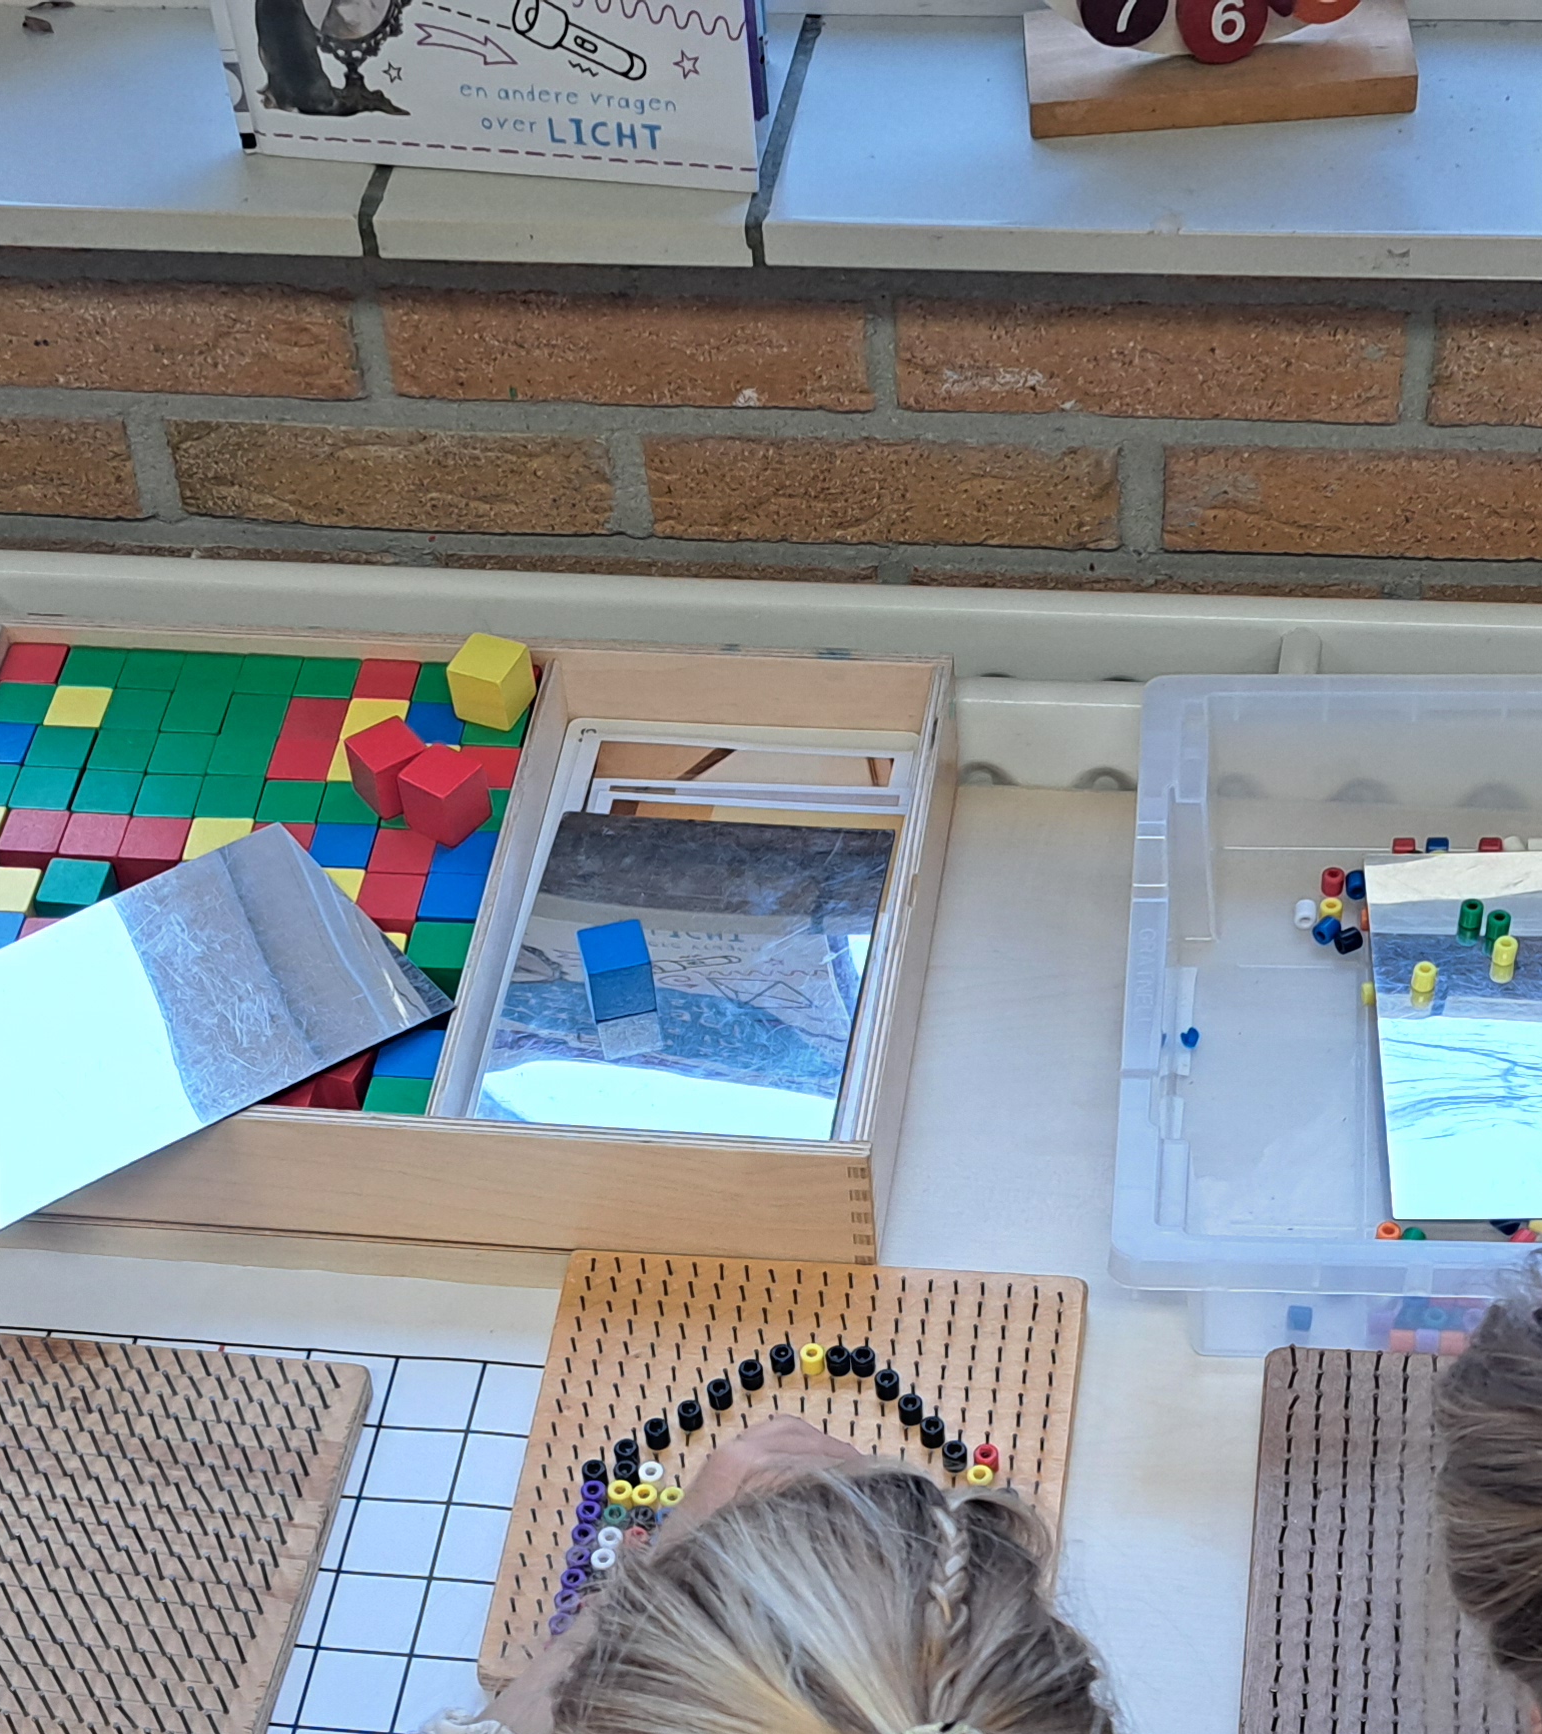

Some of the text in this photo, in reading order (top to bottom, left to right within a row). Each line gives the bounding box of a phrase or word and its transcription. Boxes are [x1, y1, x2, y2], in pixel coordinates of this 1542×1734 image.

[1211, 0, 1246, 44] 6
[460, 83, 677, 115] en andere vragen
[481, 117, 662, 150] over LICHT
